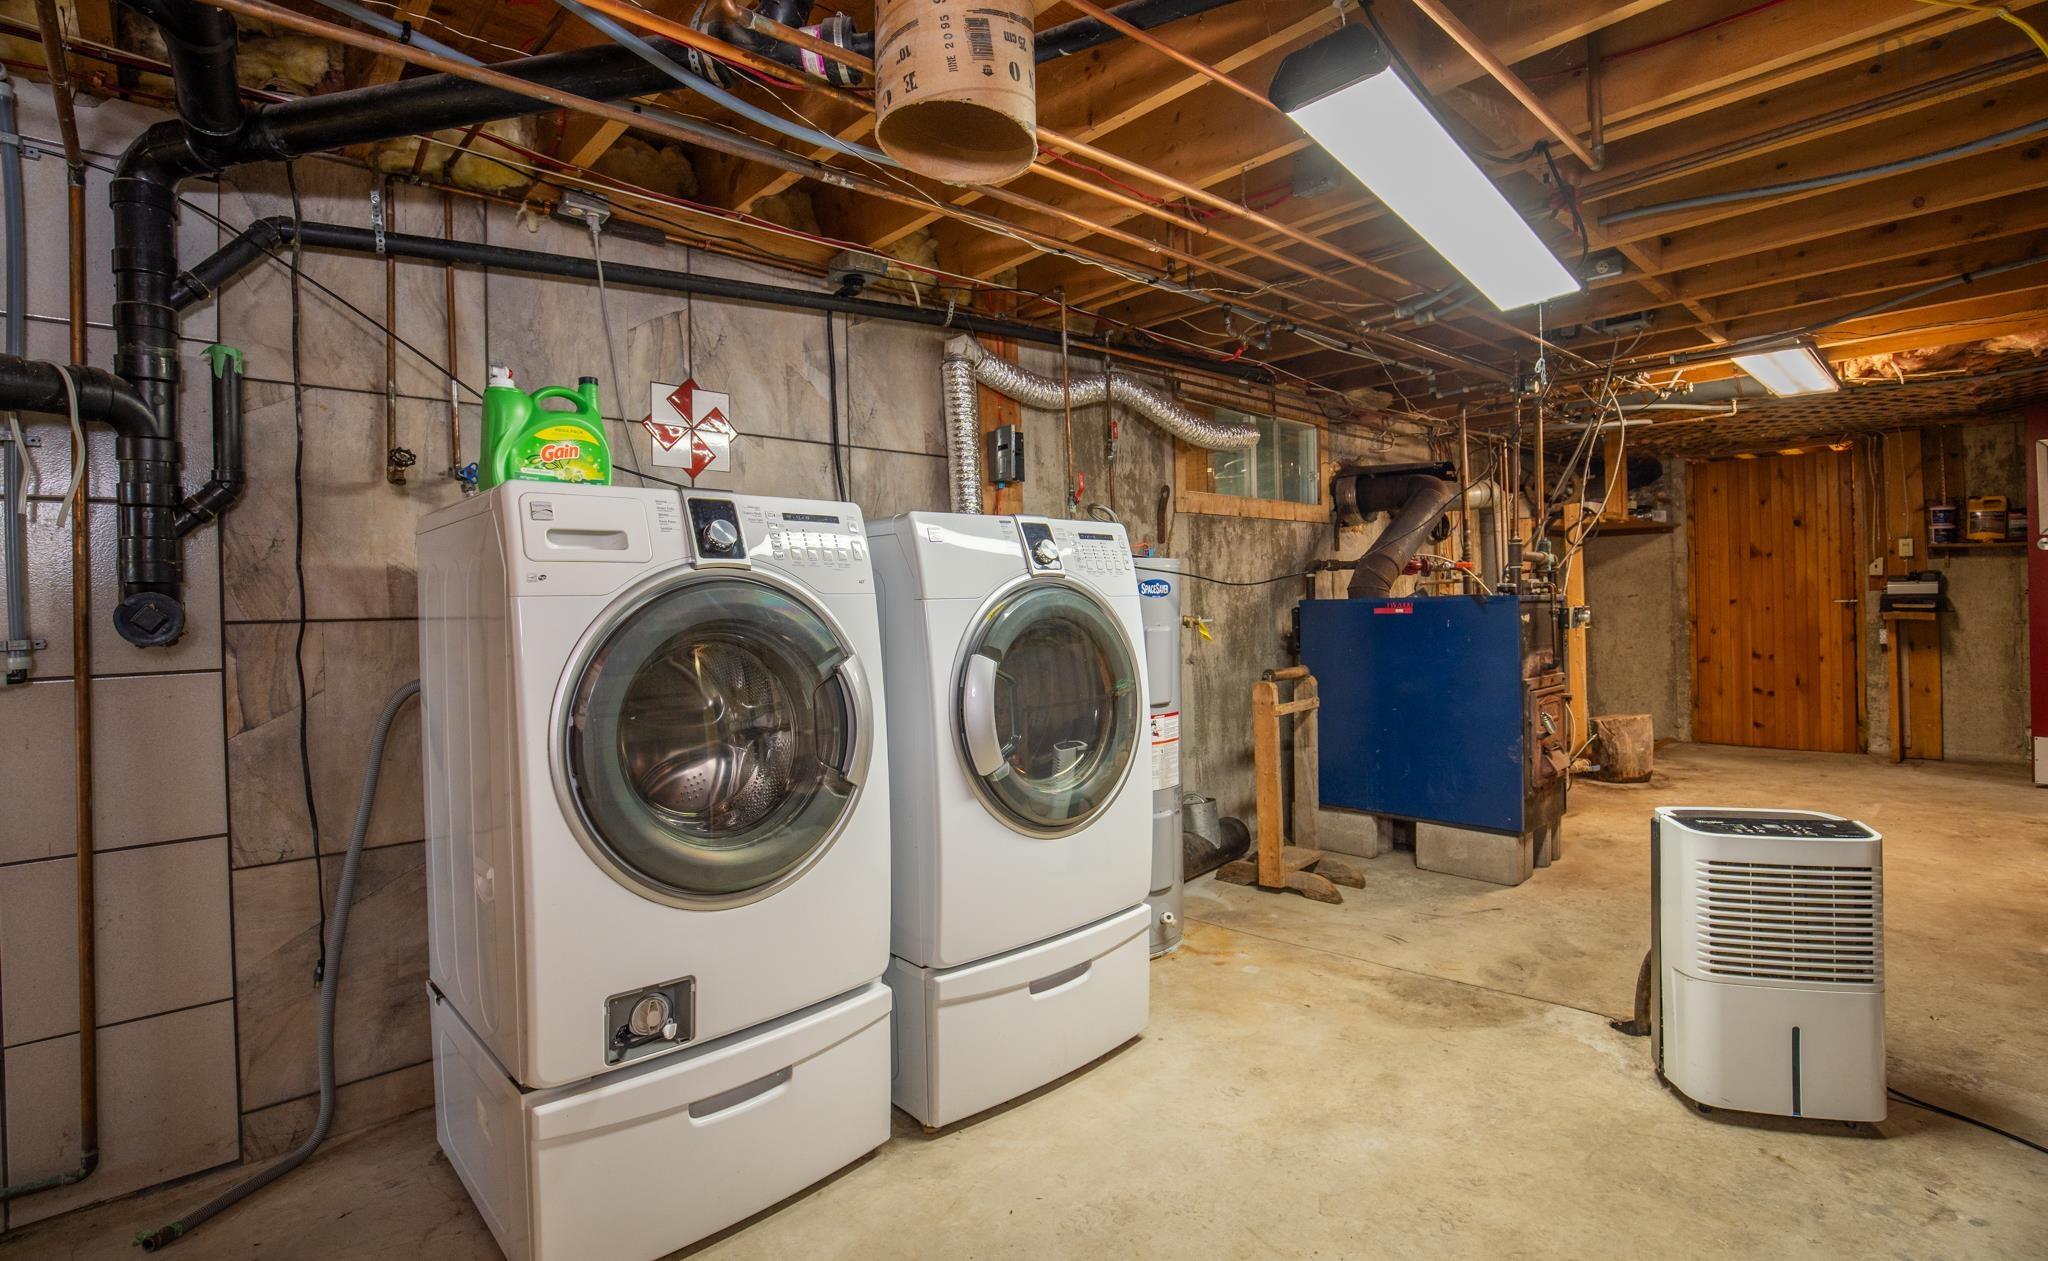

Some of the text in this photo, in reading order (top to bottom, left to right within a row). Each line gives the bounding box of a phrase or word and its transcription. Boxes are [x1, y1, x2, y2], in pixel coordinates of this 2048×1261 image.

[1003, 31, 1017, 45] cm
[947, 54, 959, 73] JUNE
[541, 444, 579, 463] Gain
